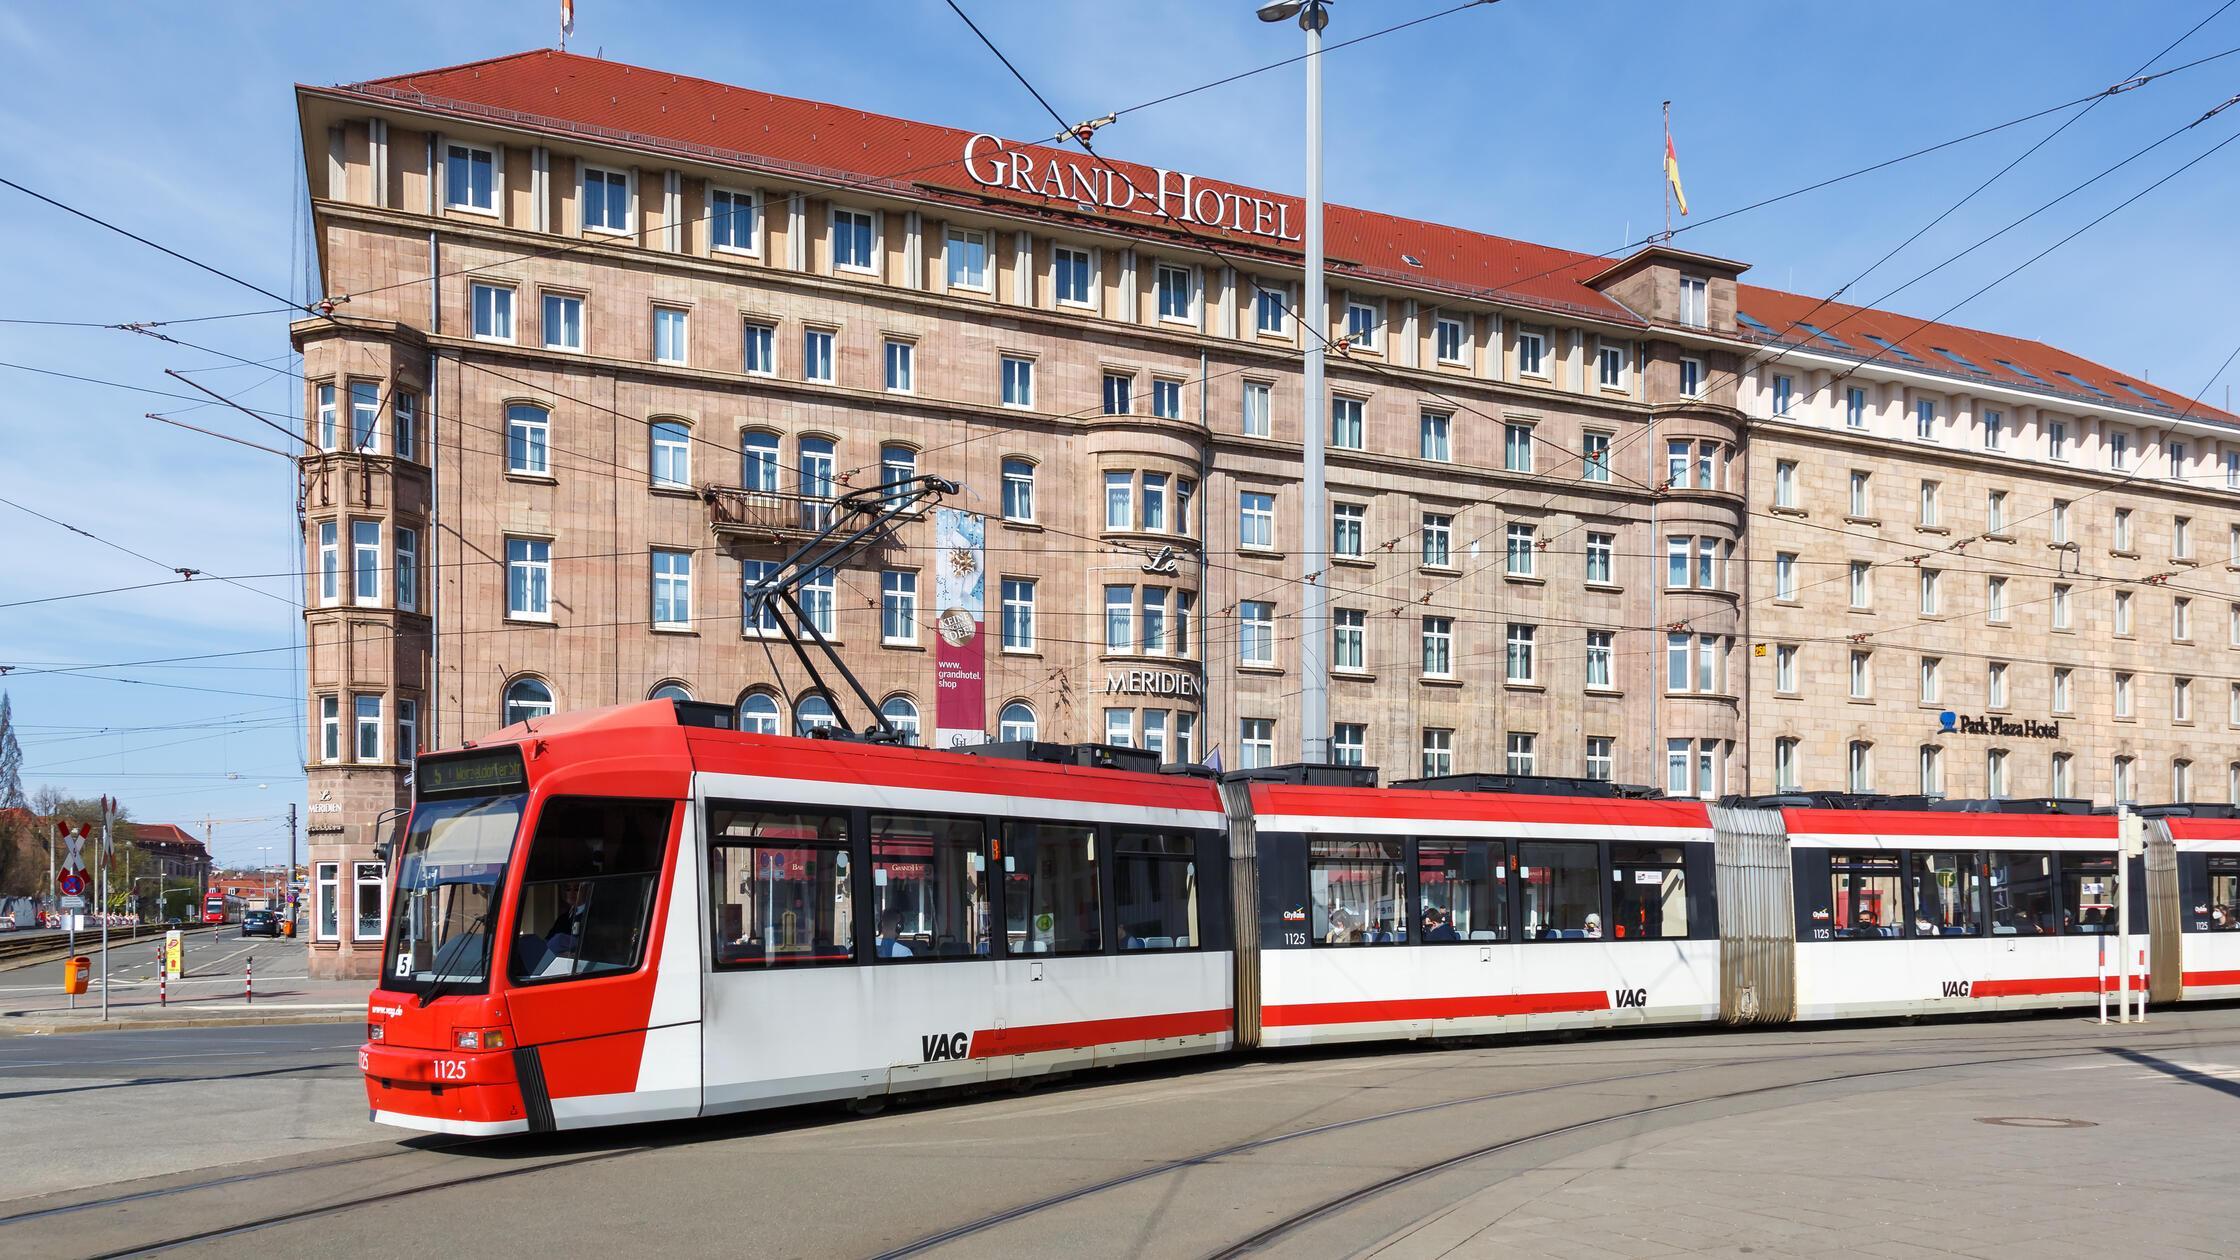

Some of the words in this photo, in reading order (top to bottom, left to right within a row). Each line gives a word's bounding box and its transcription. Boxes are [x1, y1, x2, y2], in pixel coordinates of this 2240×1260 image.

[963, 133, 1301, 241] GRAND-HOTEL
[1142, 546, 1177, 572] Le
[938, 661, 961, 669] www.
[938, 670, 981, 680] grandhotel.
[1105, 670, 1201, 697] MERIDIEN
[938, 679, 957, 690] shop
[1960, 715, 1989, 735] Park
[1990, 717, 2023, 738] Plaza
[2024, 719, 2059, 740] Hotel
[1284, 933, 1306, 945] 1125
[1813, 929, 1829, 938] 1125
[399, 956, 408, 974] 5
[1615, 988, 1647, 1008] VAG
[1942, 980, 1969, 998] VAG
[922, 1032, 968, 1062] VAG
[433, 1060, 466, 1079] 1125
